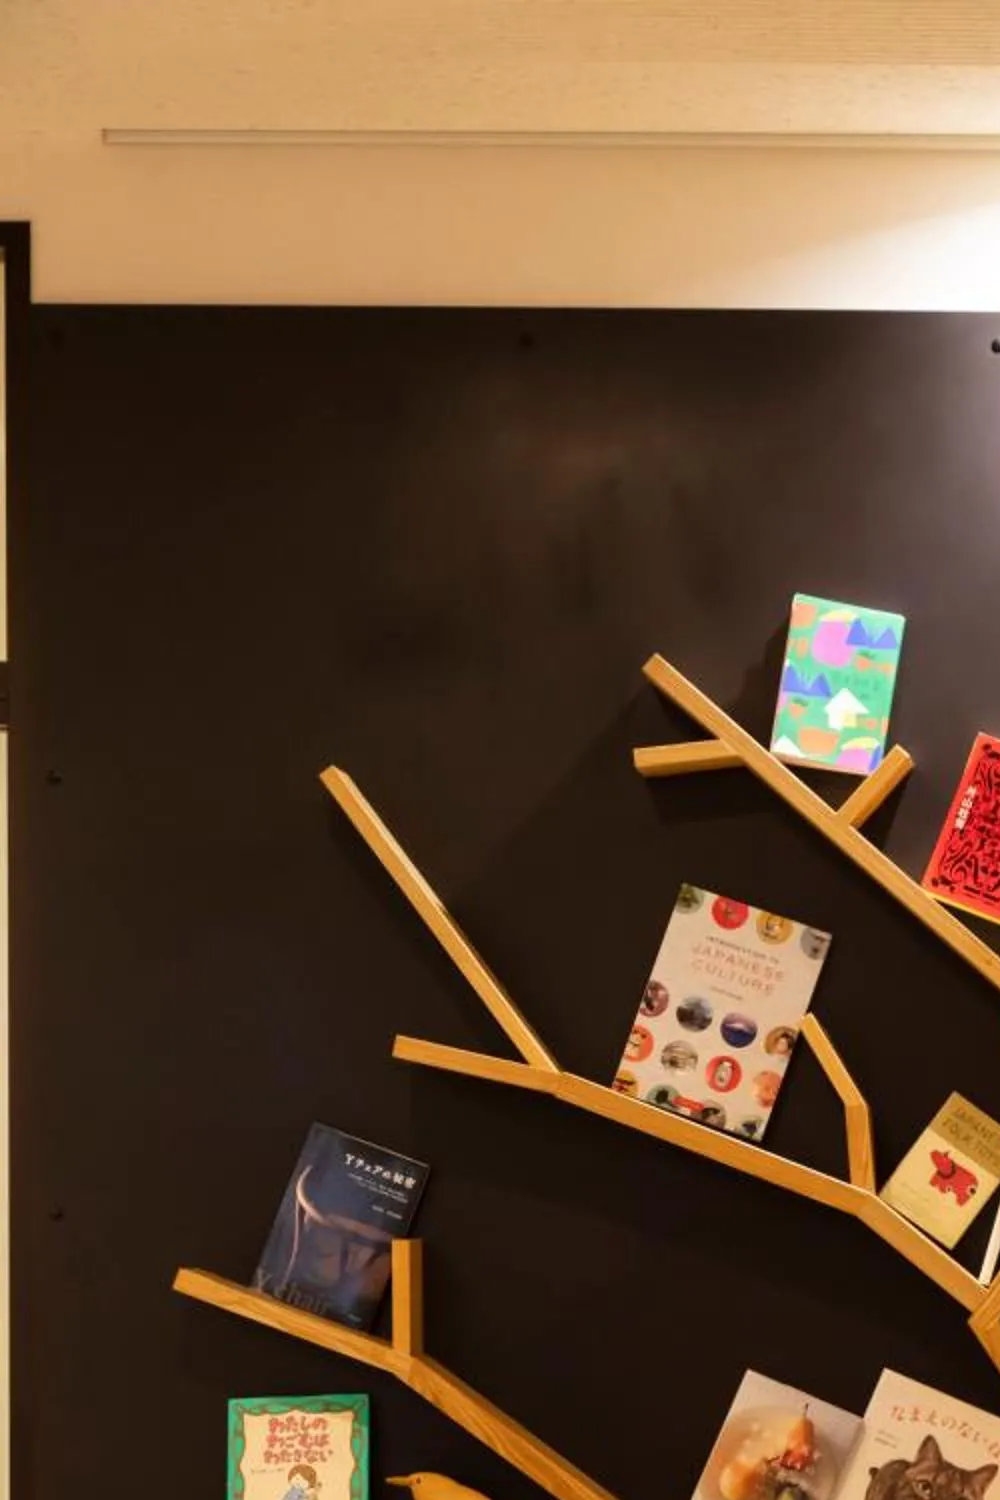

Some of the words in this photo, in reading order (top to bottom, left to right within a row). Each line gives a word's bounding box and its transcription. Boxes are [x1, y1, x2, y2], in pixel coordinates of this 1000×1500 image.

[690, 958, 776, 996] CULTURE
[692, 944, 786, 982] JAPANESE
[268, 1415, 328, 1433] わたしの
